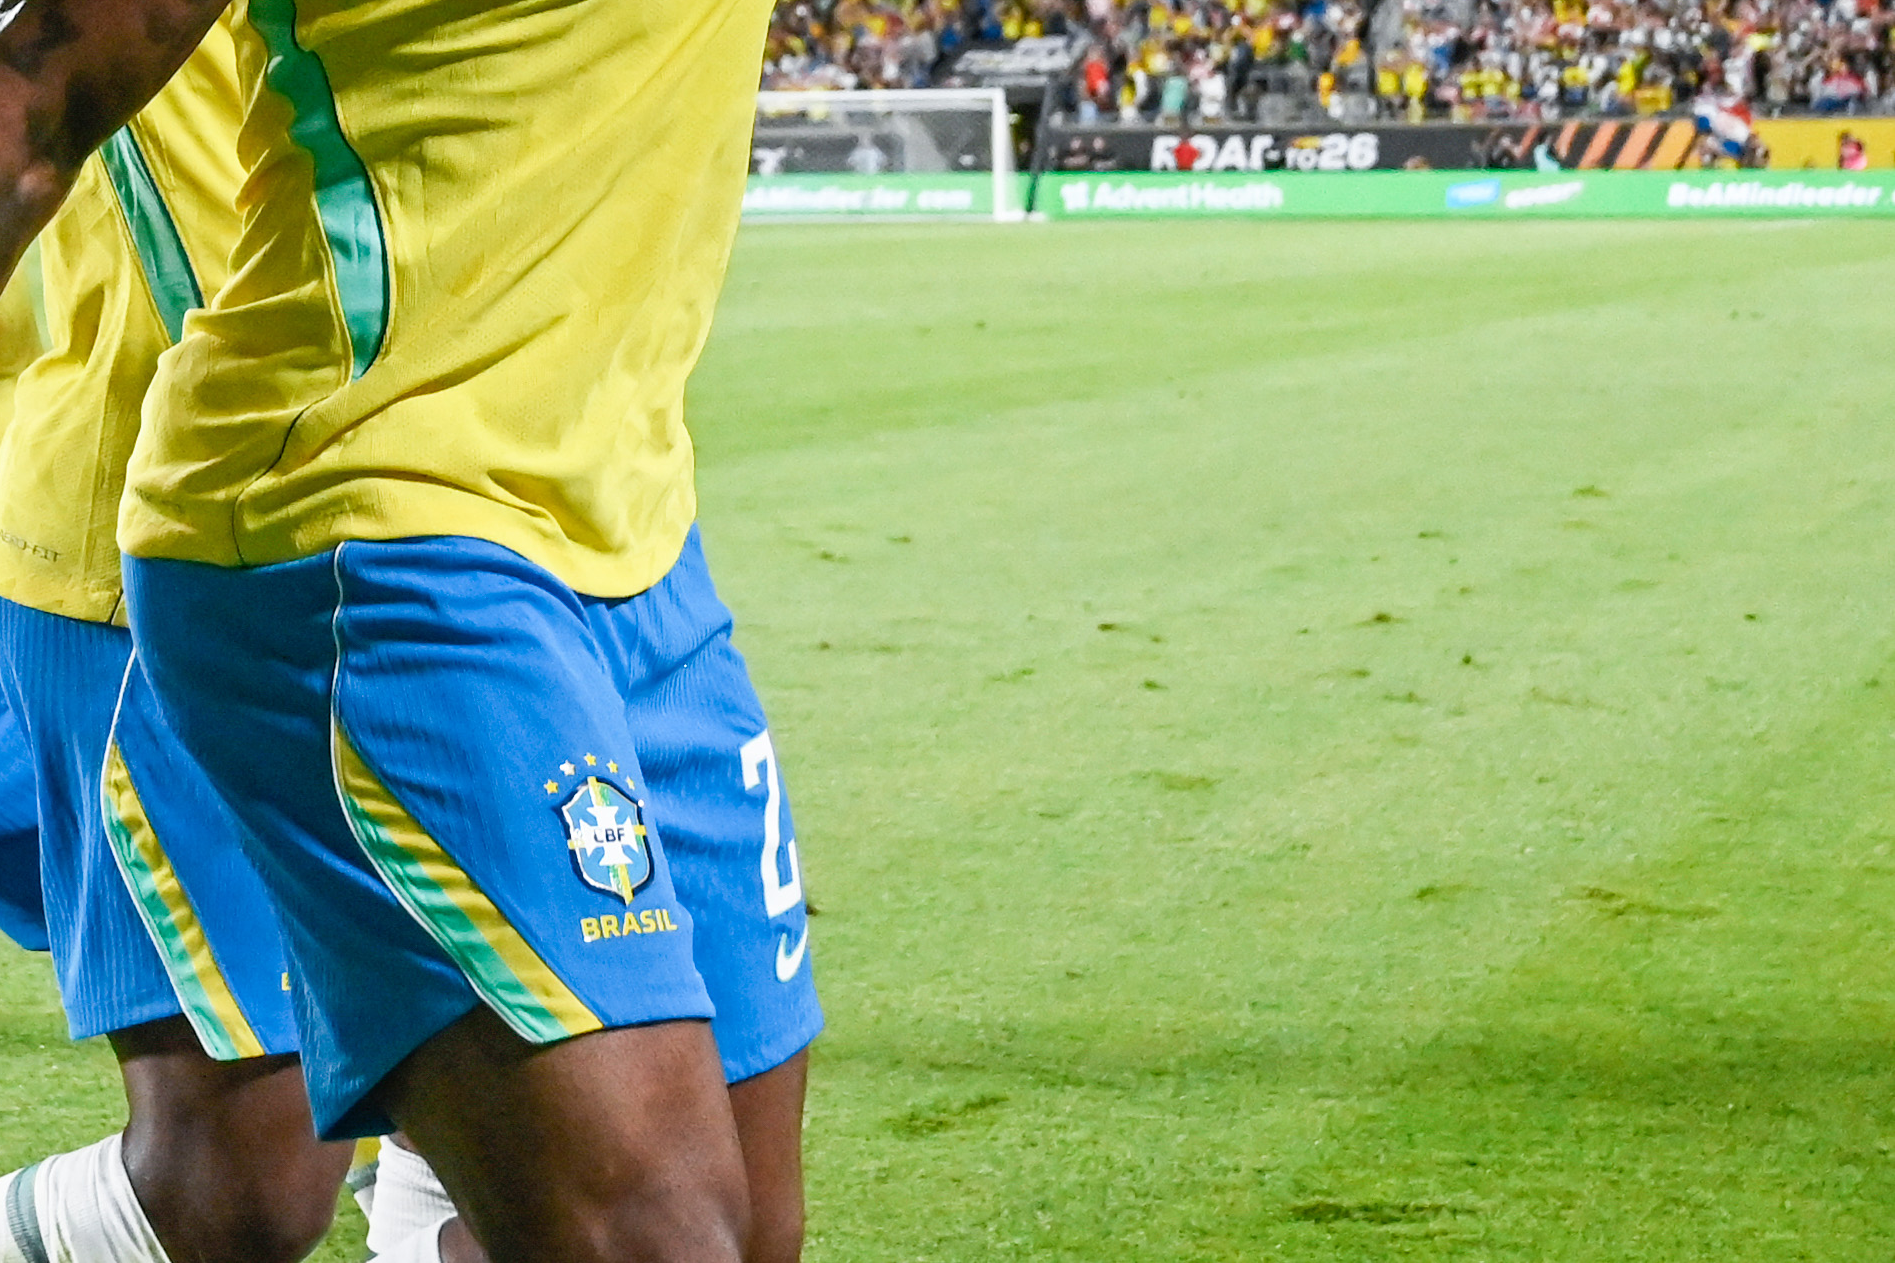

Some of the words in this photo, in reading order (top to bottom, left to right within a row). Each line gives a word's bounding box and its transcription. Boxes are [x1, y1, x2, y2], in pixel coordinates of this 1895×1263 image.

[1317, 132, 1380, 171] 26
[593, 827, 625, 843] CBF
[580, 908, 678, 943] BRASIL
